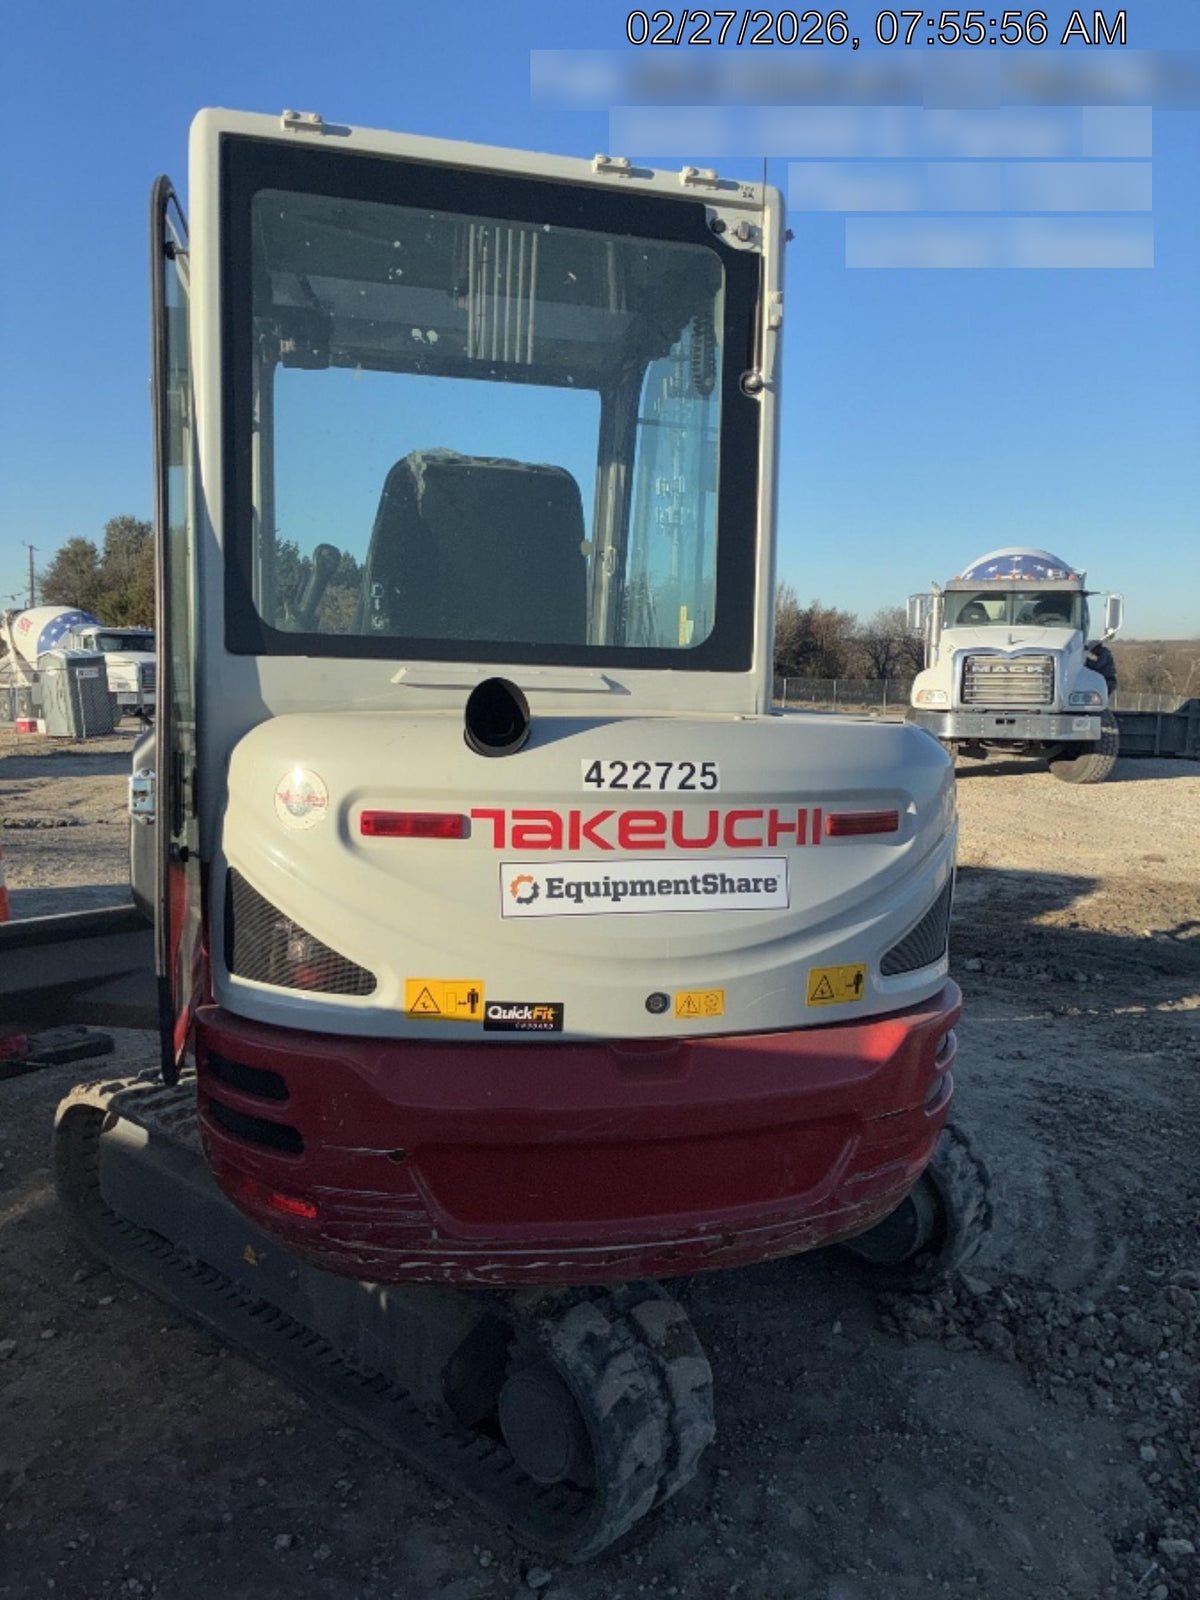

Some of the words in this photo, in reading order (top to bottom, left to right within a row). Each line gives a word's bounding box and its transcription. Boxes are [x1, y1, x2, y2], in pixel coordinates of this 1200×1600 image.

[972, 665, 1045, 673] MACK
[584, 760, 719, 791] 422725
[545, 873, 778, 903] EquipmentShare
[488, 1005, 555, 1020] QuickFit
